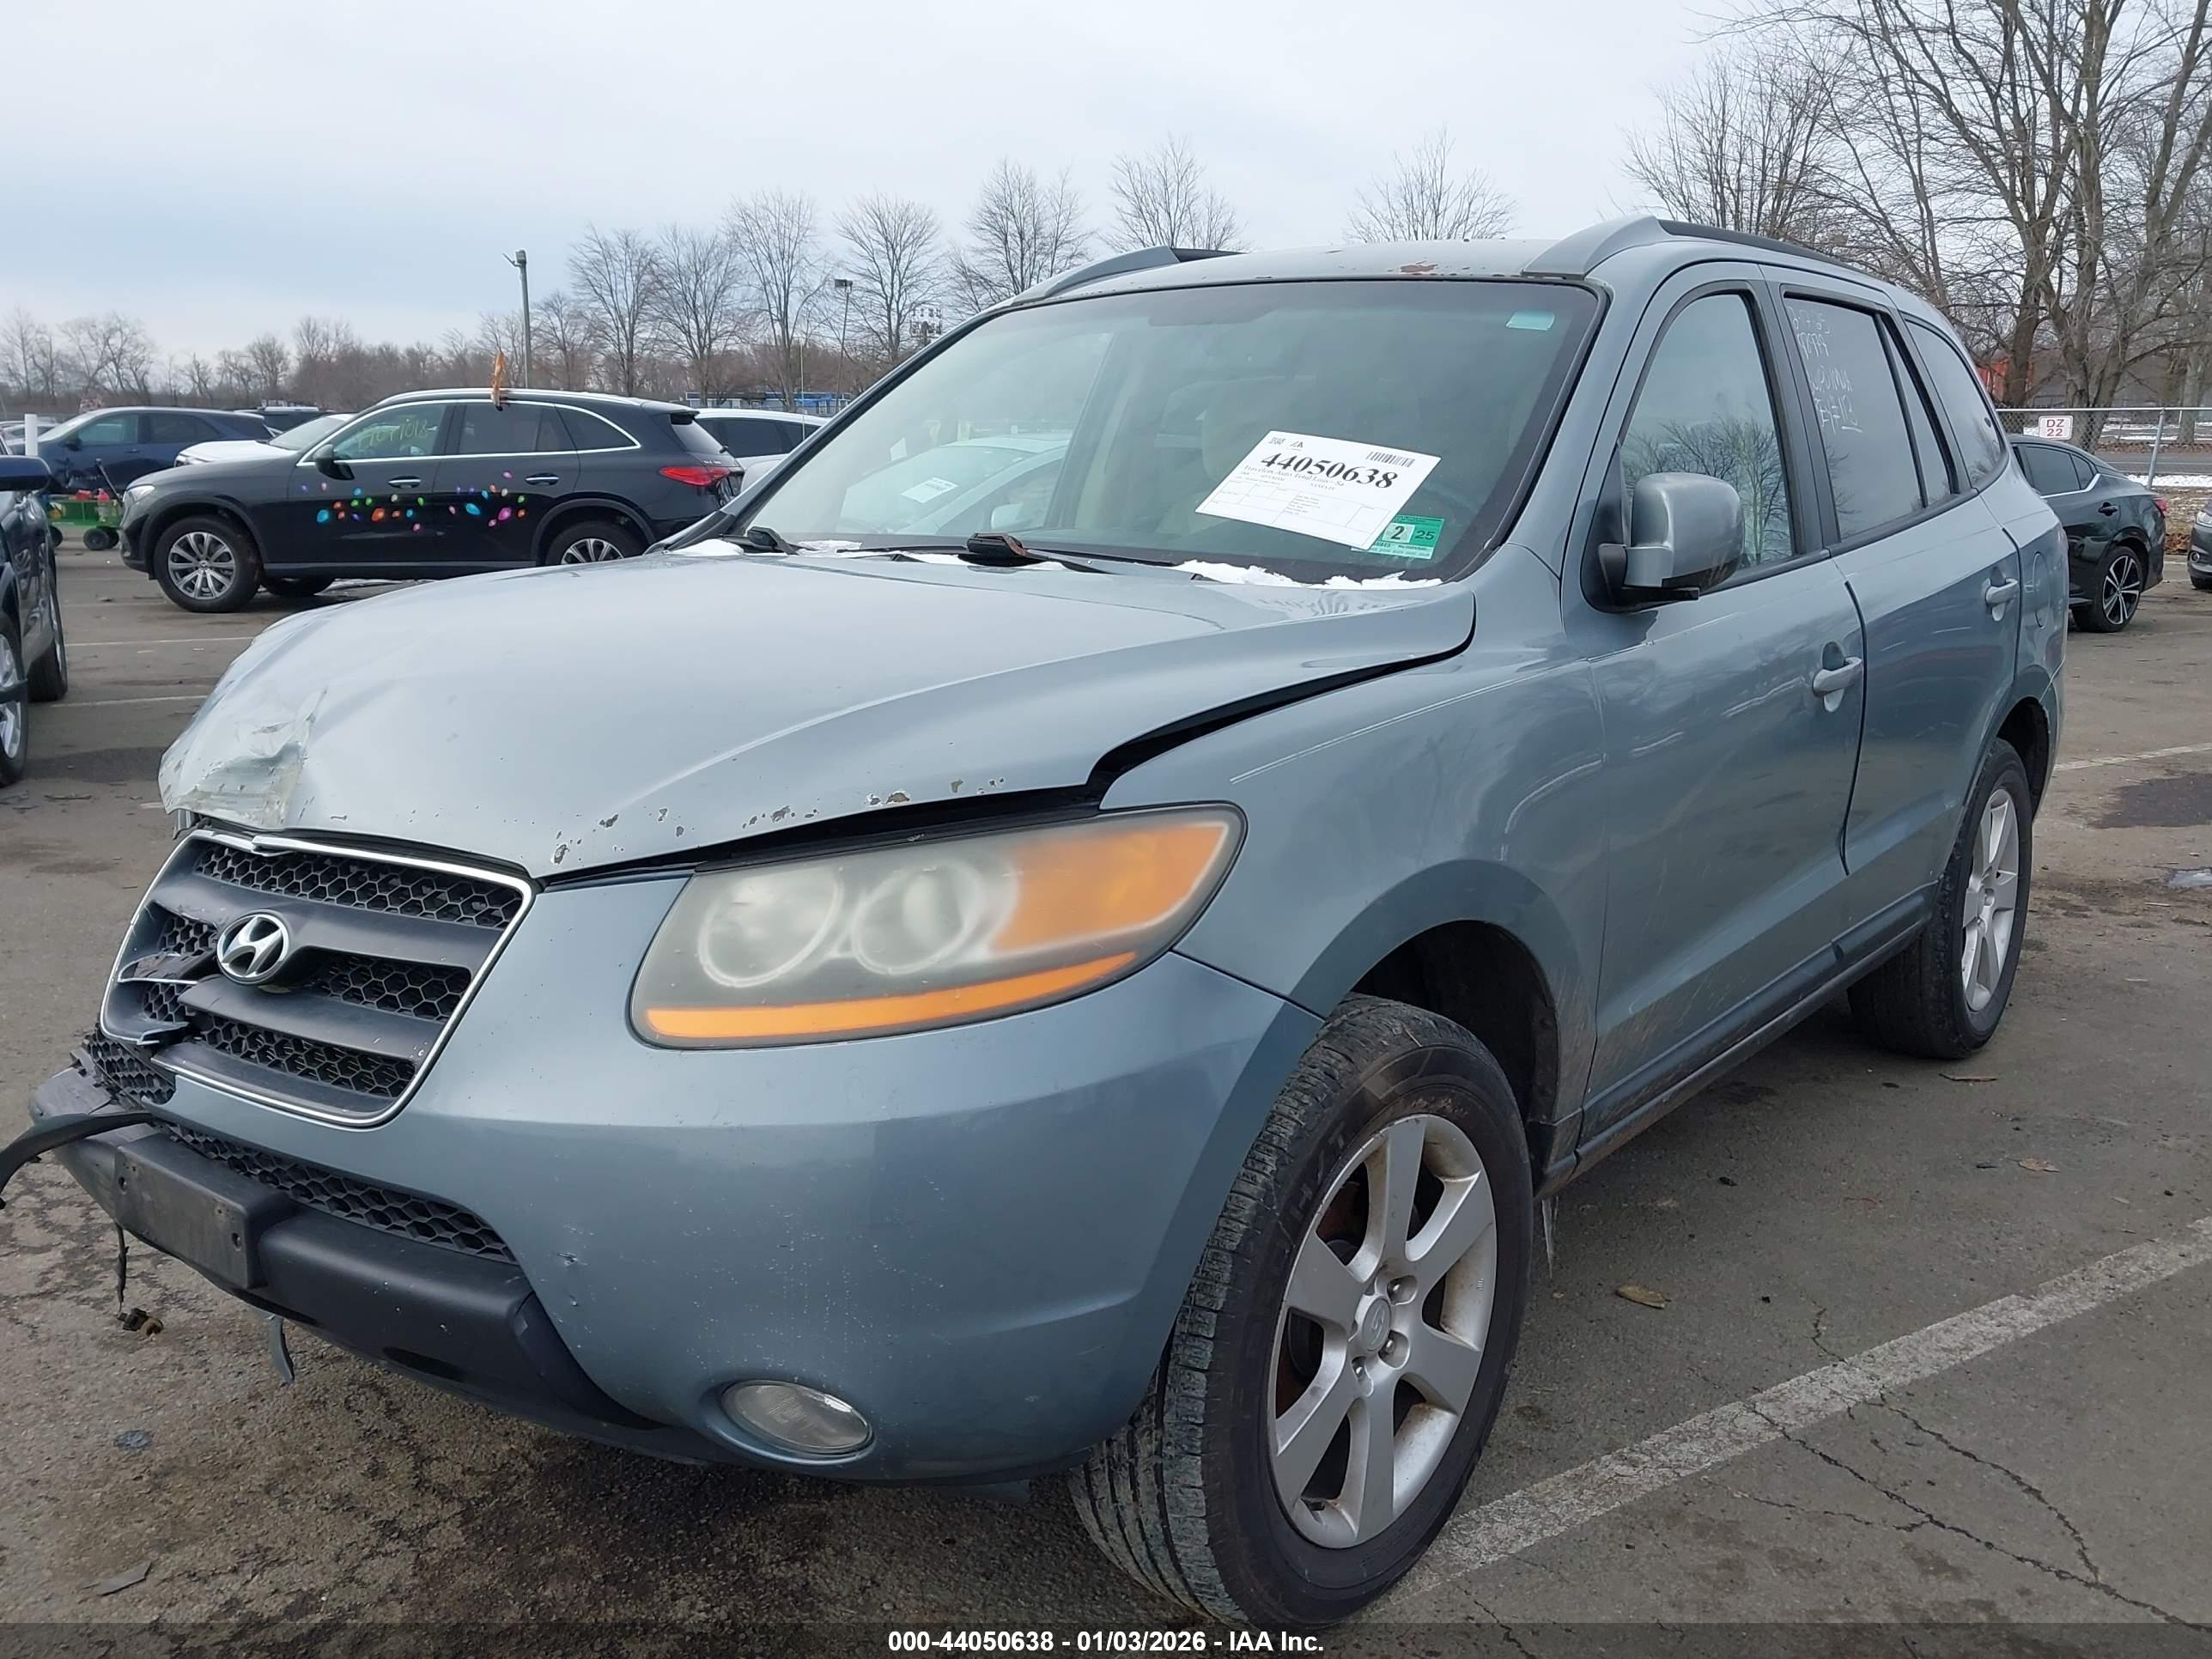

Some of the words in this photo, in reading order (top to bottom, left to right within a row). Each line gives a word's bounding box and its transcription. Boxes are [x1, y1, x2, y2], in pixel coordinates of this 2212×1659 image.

[2046, 419, 2065, 428] DZ
[2046, 428, 2063, 437] 22
[1261, 453, 1398, 489] 44050638
[1390, 526, 1406, 540] 2
[1415, 530, 1436, 540] 25
